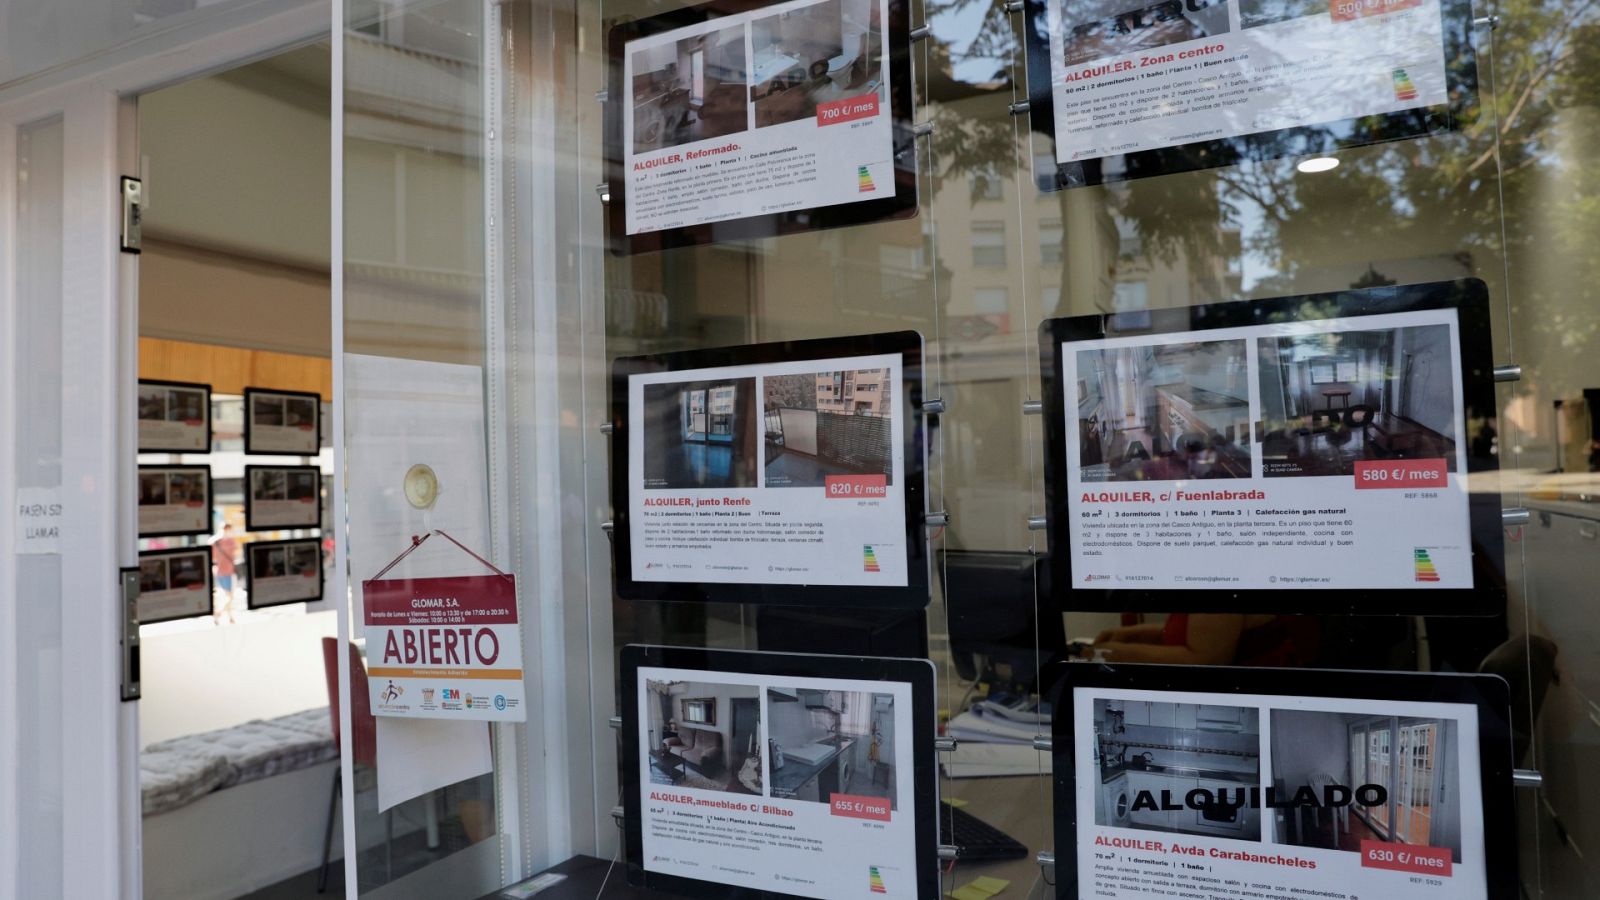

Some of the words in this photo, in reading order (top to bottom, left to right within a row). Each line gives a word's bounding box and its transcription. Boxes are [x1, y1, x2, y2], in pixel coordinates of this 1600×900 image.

[1338, 2, 1363, 15] 500
[1065, 60, 1136, 82] ALQUILER.
[1140, 51, 1174, 67] Zona
[1178, 42, 1224, 60] centro
[1096, 75, 1134, 88] dormitorios
[1146, 69, 1163, 79] baño
[1203, 58, 1221, 67] Buen
[822, 107, 841, 120] 700
[854, 102, 874, 115] mes
[633, 153, 683, 172] ALQUILER,
[686, 142, 741, 160] Reformado.
[1362, 469, 1388, 481] 580
[1409, 469, 1440, 480] mes
[831, 483, 851, 494] 620
[865, 485, 885, 494] mes
[644, 497, 694, 507] ALQUILER,
[695, 497, 720, 507] junto
[723, 497, 751, 505] Renfe
[1081, 491, 1155, 504] ALQUILER,
[1159, 490, 1171, 501] c/
[1176, 489, 1265, 501] Fuenlabrada
[445, 597, 460, 607] S.A.
[383, 627, 500, 666] ABIERTO
[1130, 783, 1388, 812] ALQUILADO
[762, 804, 793, 817] Bilbao
[835, 800, 852, 811] 655
[866, 805, 886, 815] mes
[1094, 835, 1167, 853] ALQUILER,
[1170, 843, 1205, 856] Avda
[1209, 847, 1316, 868] Carabancheles
[1368, 849, 1394, 862] 630
[1414, 856, 1444, 868] mes
[1132, 857, 1168, 866] dormitorio
